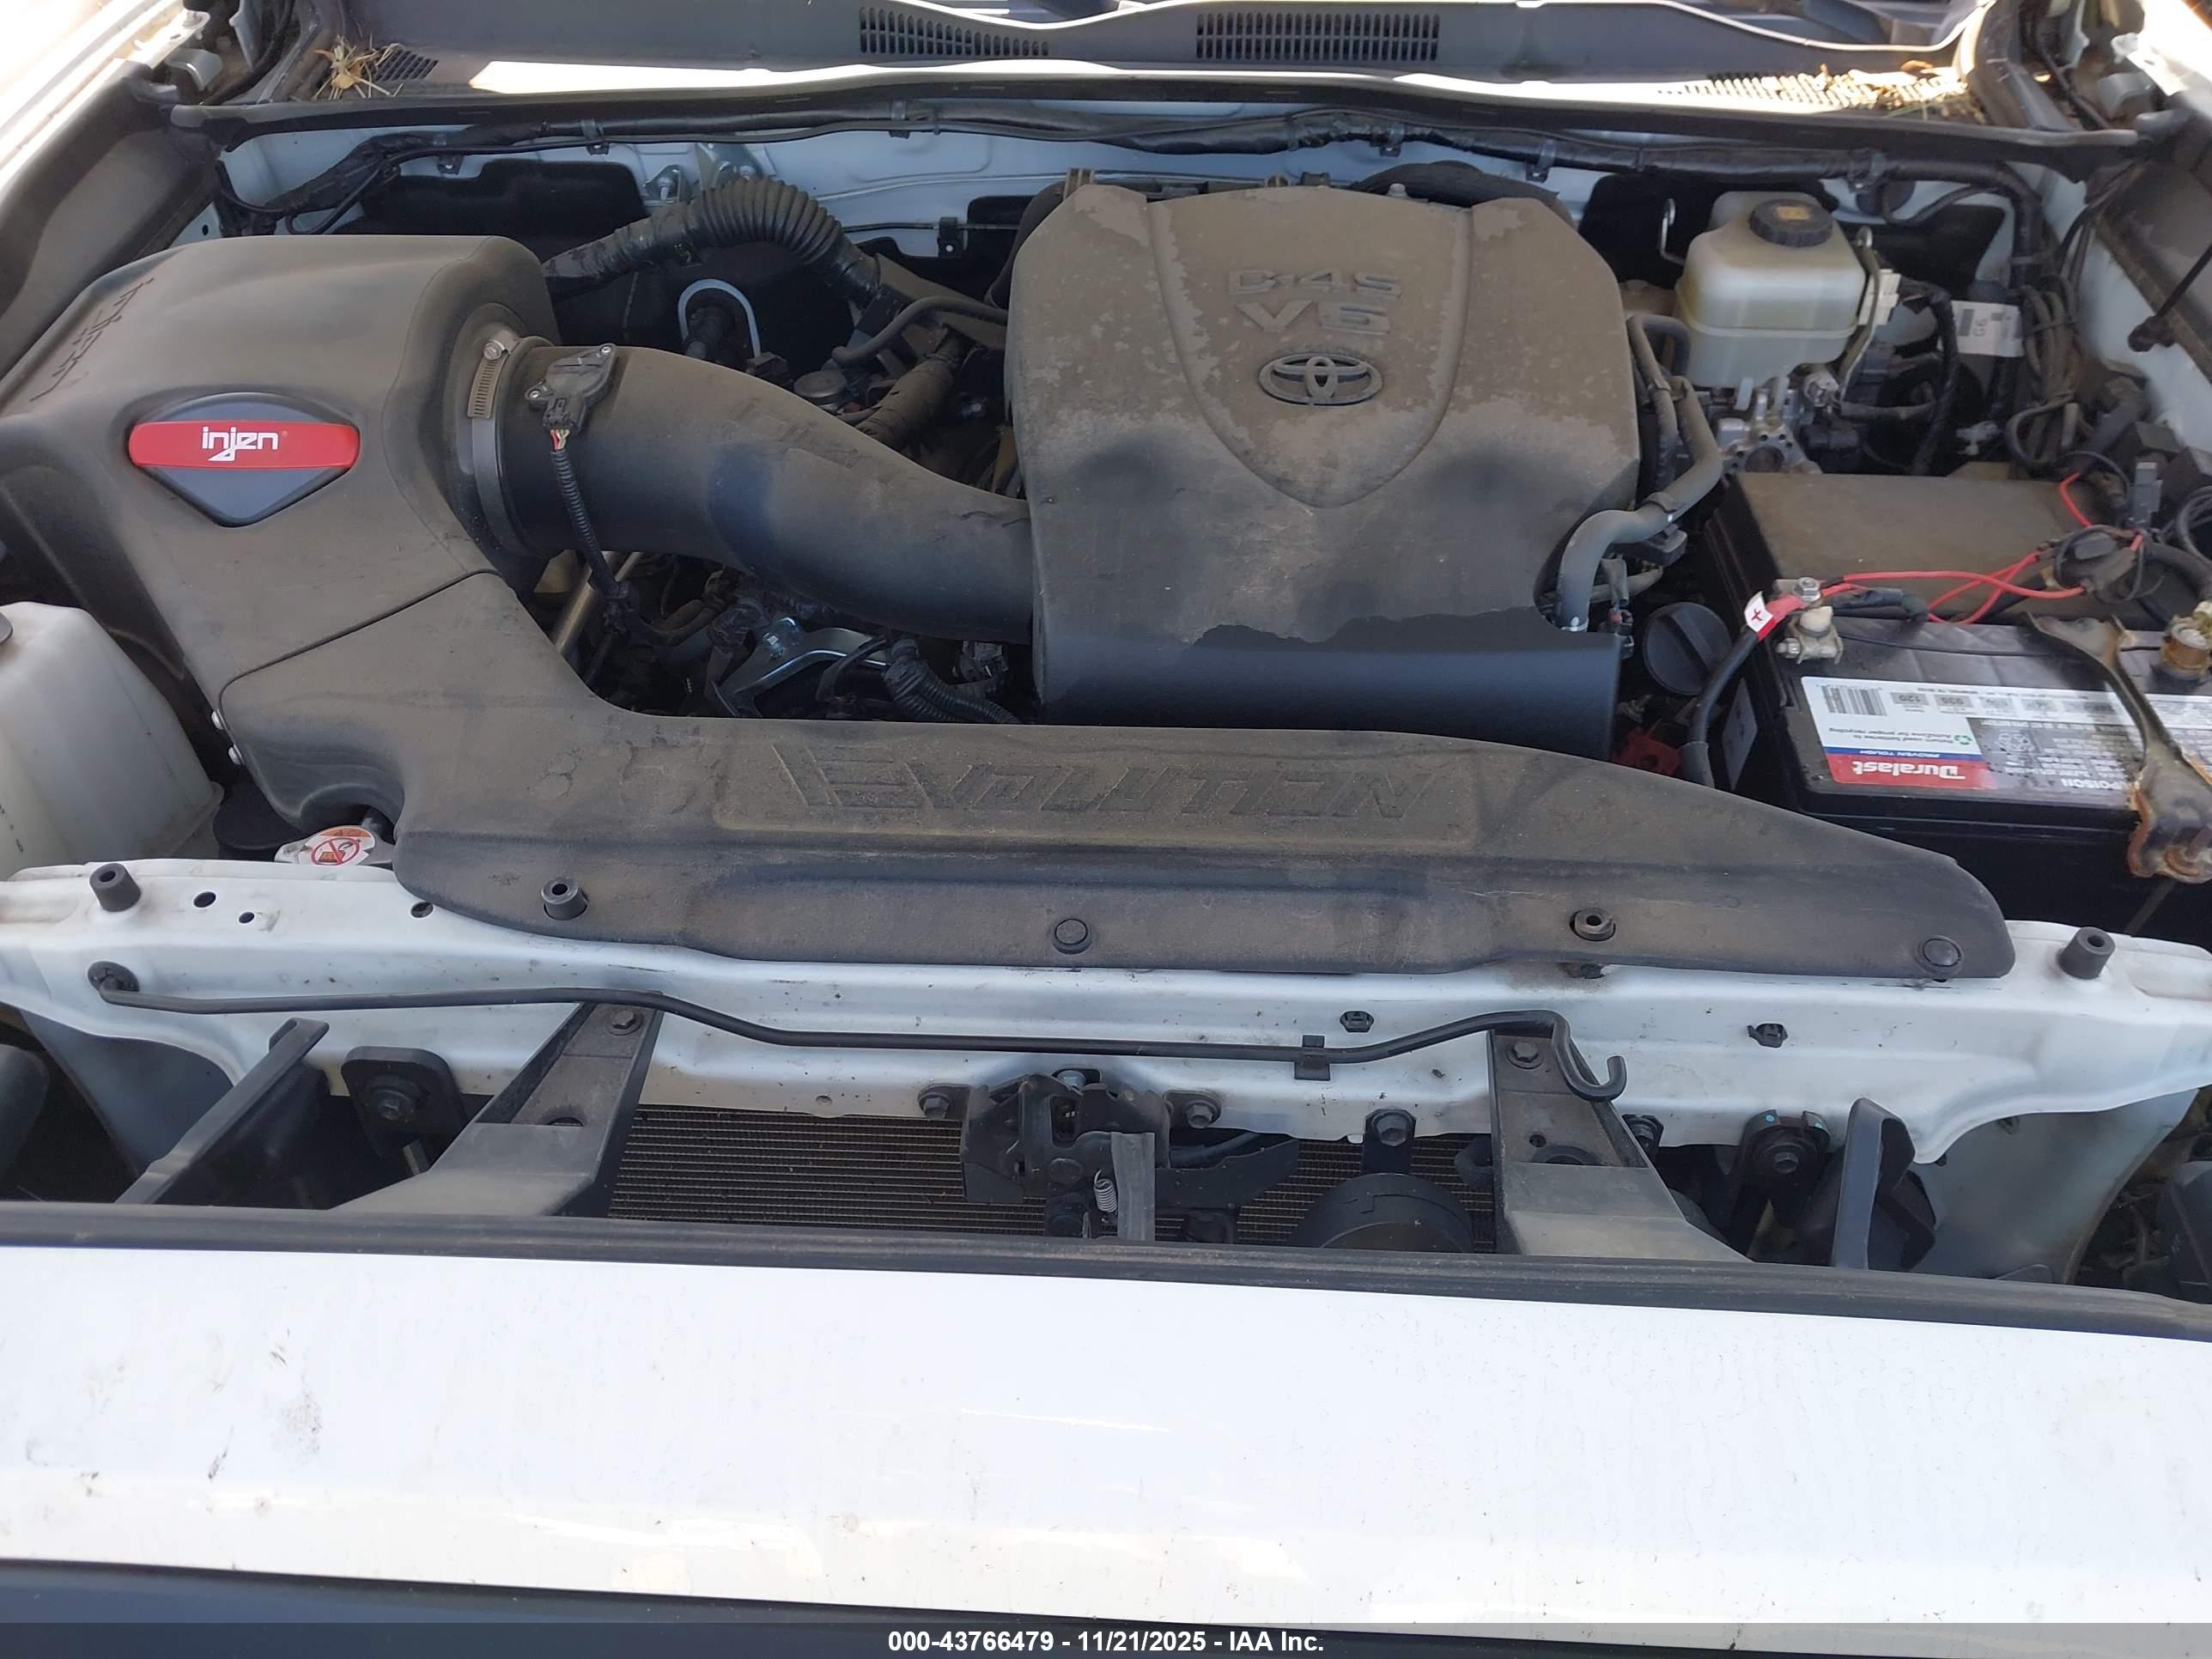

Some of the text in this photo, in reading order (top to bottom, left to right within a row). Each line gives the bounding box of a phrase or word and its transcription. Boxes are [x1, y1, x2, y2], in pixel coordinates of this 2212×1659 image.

[1235, 301, 1391, 335] V6
[202, 426, 278, 462] injen
[772, 741, 1437, 818] EVOLUTION
[1851, 761, 1966, 780] Duralast
